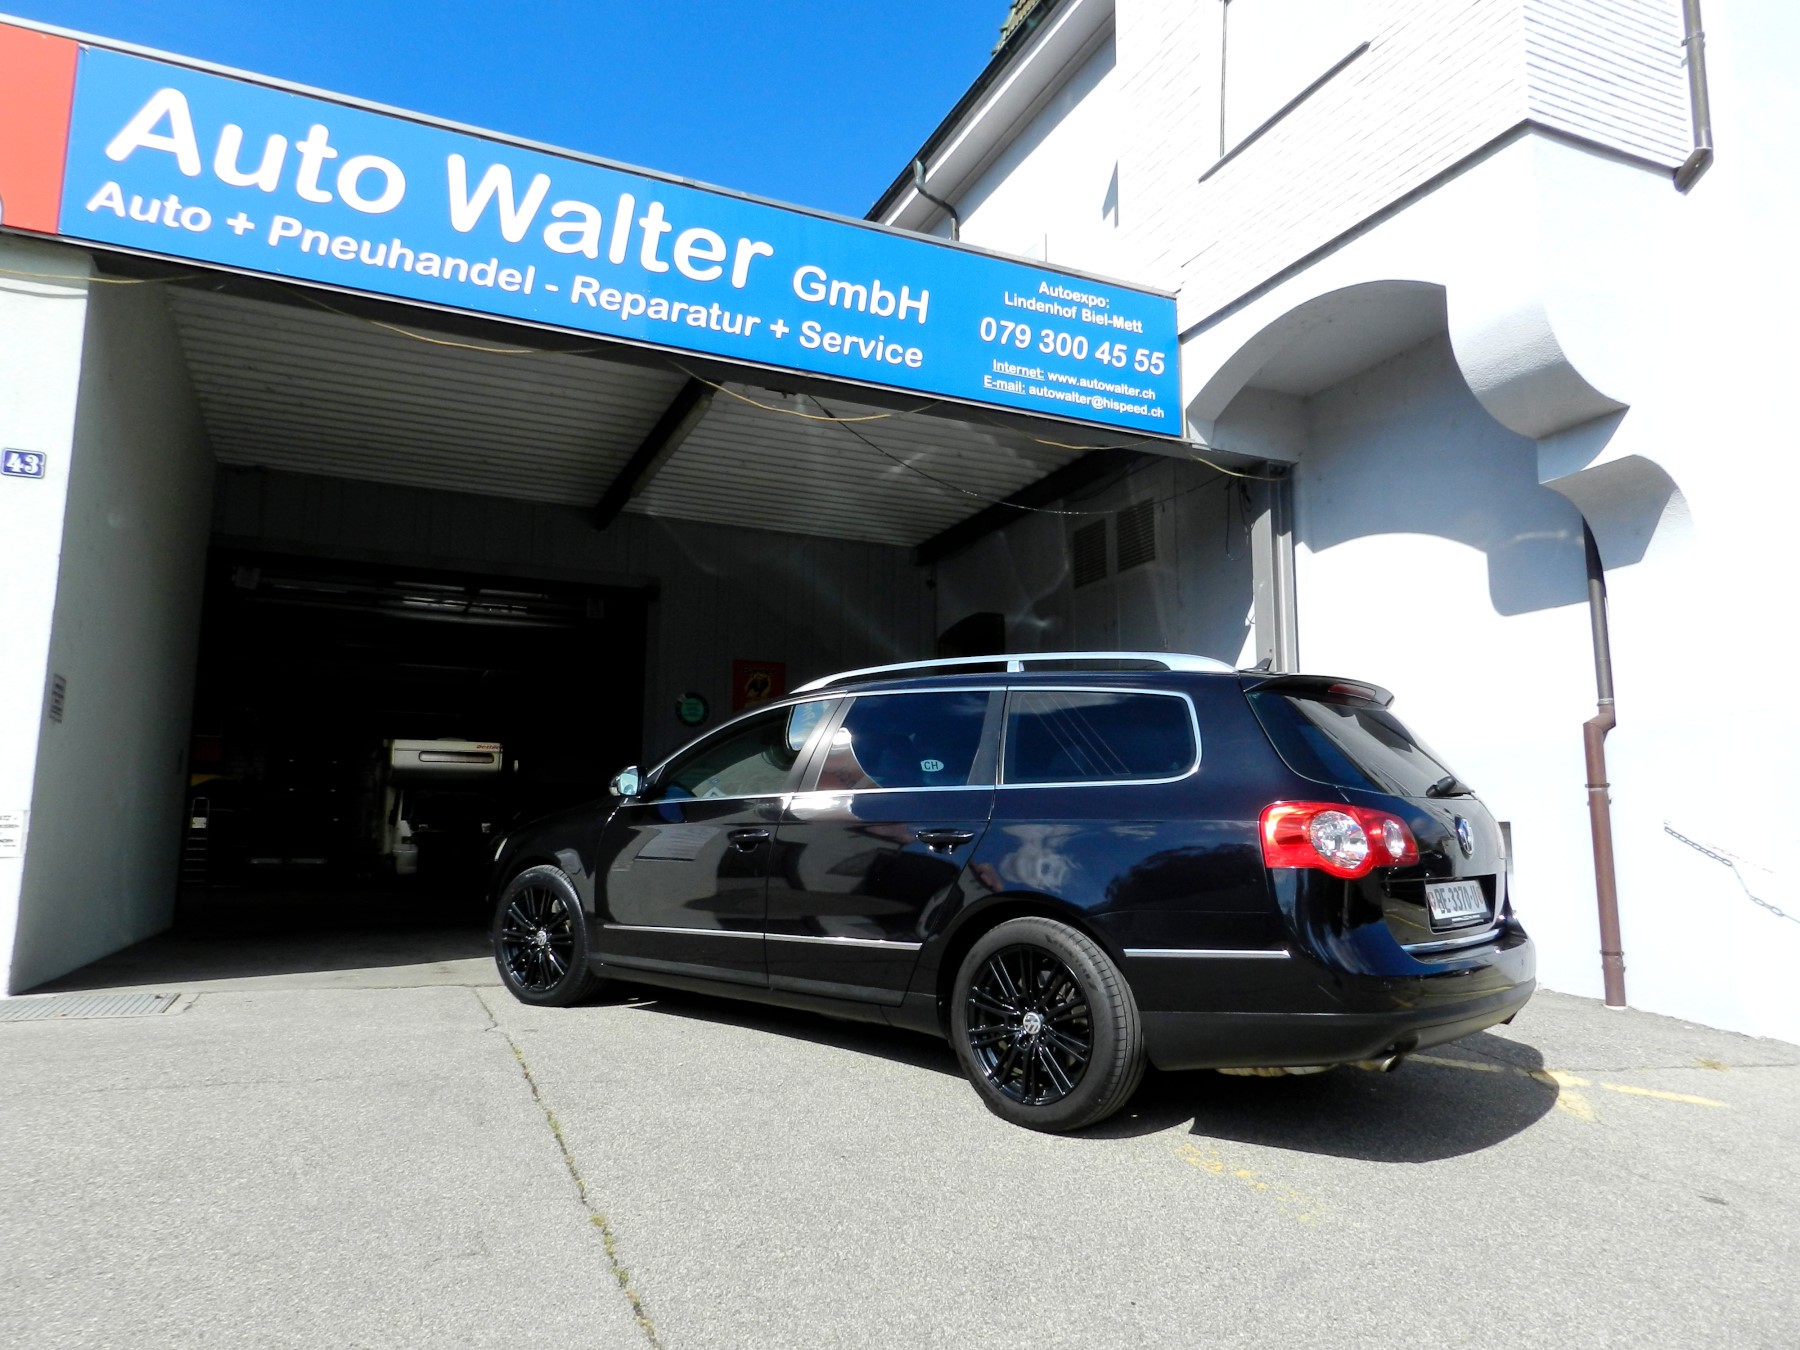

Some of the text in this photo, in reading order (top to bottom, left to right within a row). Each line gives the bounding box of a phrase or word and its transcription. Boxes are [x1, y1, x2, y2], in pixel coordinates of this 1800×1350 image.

[103, 86, 930, 324] Auto Walter GmbH
[84, 180, 213, 233] Auto
[225, 211, 256, 236] +
[267, 214, 536, 295] Pneuhandel
[570, 274, 762, 337] Reparatur
[769, 318, 790, 339] +
[799, 320, 923, 368] Service
[1038, 281, 1110, 308] Autoexpo:
[1004, 291, 1143, 334] Lindenhof Biel-Mett
[979, 316, 1165, 375] 079 300 45 55
[983, 374, 1165, 418] E-mail: autowalter@hispeed.ch
[992, 359, 1156, 400] Internet: www.autowalter.ch
[7, 453, 38, 473] 43
[924, 761, 938, 769] CH
